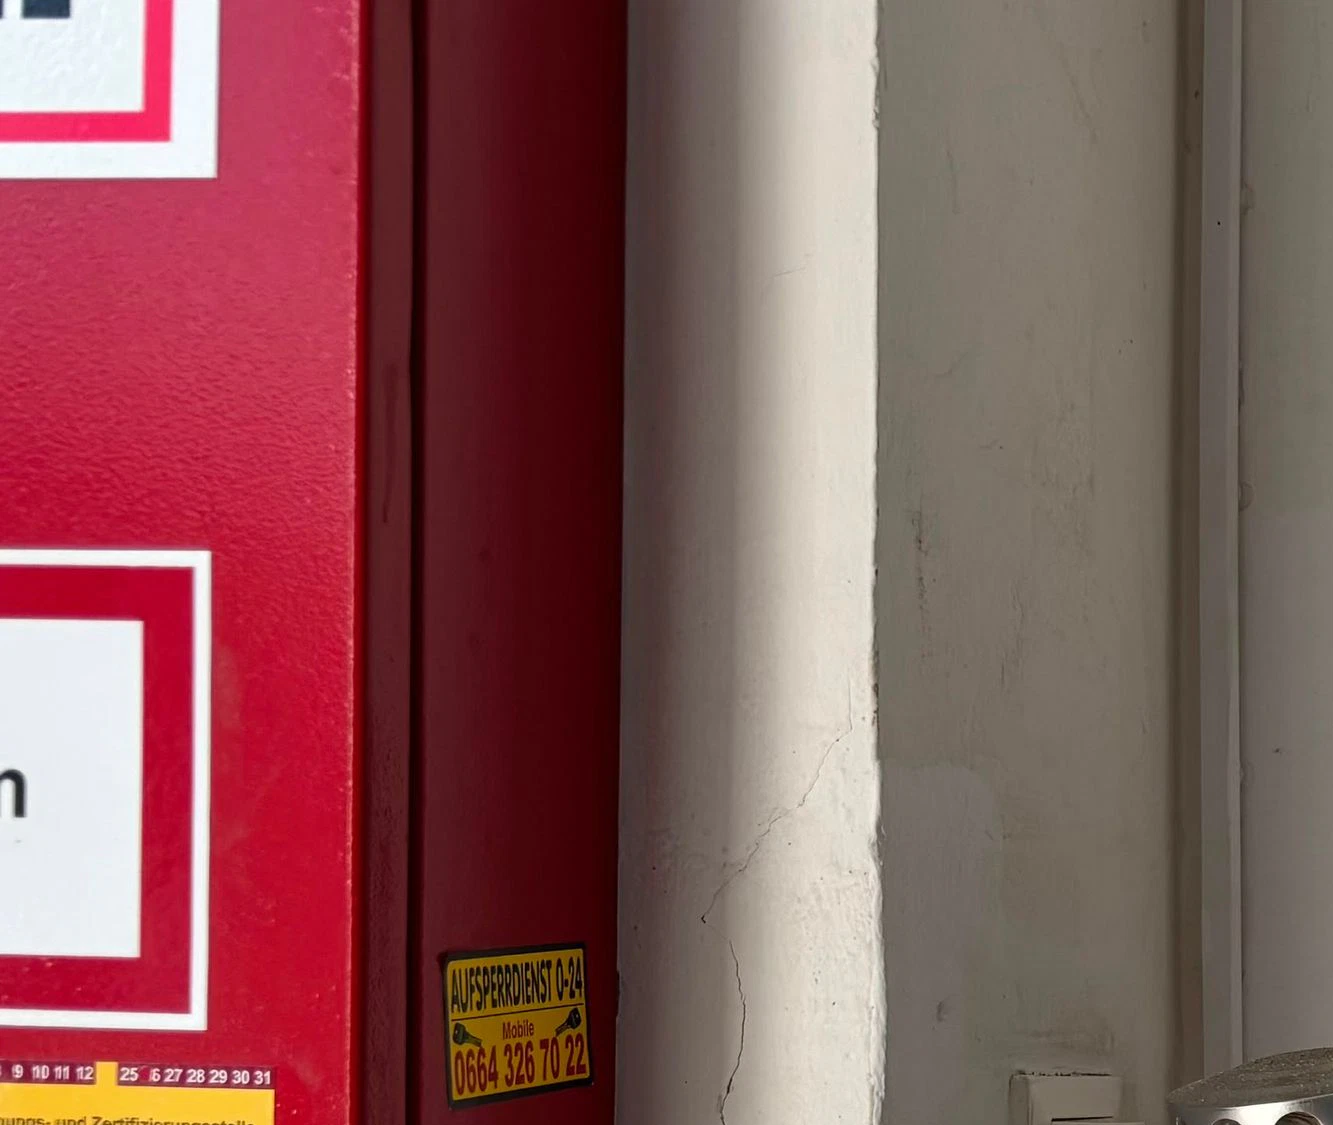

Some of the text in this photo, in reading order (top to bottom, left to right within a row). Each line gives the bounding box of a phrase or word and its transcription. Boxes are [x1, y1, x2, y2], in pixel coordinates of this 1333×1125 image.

[452, 957, 582, 1013] AUFSPERRDIENST 0-24
[503, 1020, 534, 1040] Mobile
[32, 1065, 49, 1079] 10
[54, 1065, 69, 1079] 11
[77, 1066, 94, 1080] 12
[454, 1033, 586, 1095] 0664 326 70 22
[120, 1068, 271, 1084] 25 27 28 29 30 31
